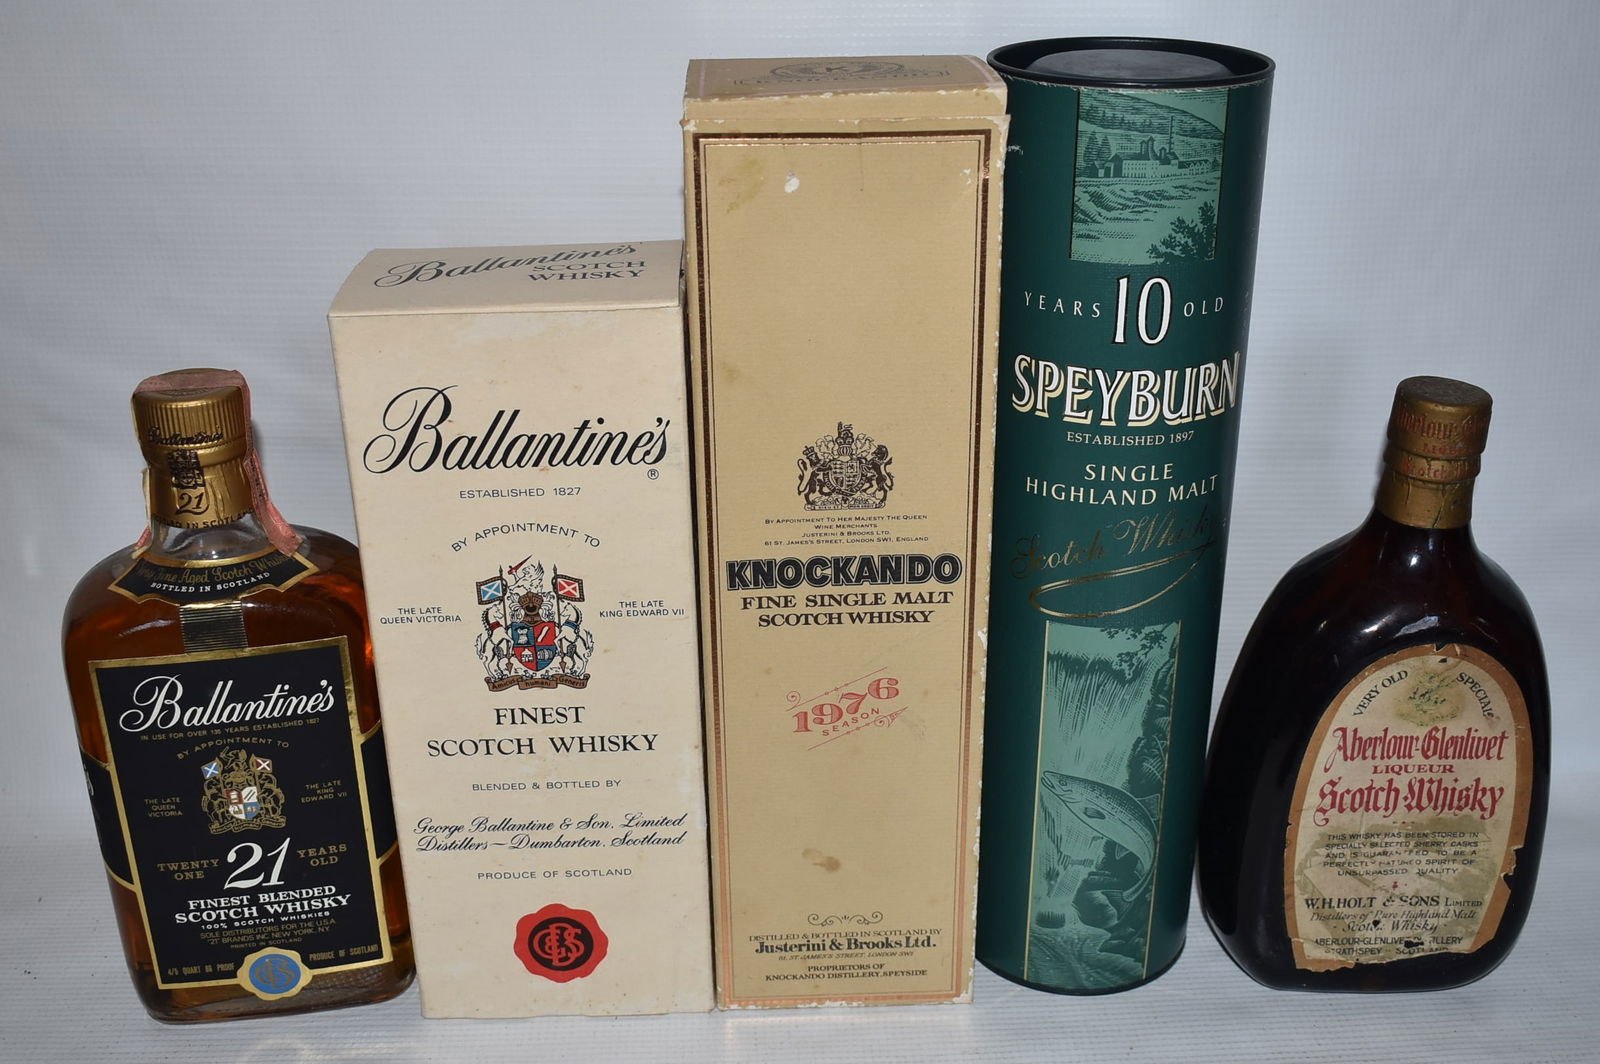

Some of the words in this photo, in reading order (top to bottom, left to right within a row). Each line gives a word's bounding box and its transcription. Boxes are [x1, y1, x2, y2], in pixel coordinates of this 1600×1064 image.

[374, 244, 637, 288] Ballantine's
[531, 260, 645, 272] SCOTCH
[527, 269, 645, 282] WHISKY
[1024, 291, 1101, 318] YEARS
[1112, 274, 1173, 345] 10
[1183, 297, 1224, 317] OLD
[1012, 351, 1241, 427] SPEYBURN
[363, 384, 671, 474] Ballantine's
[1066, 431, 1165, 446] ESTABLISHED
[1170, 430, 1195, 443] 1897
[1084, 463, 1174, 482] SINGLE
[459, 487, 545, 500] ESTABLISHED
[553, 486, 581, 496] 1827
[1026, 476, 1157, 505] HIGHLAND
[1168, 474, 1219, 503] MALT
[175, 491, 210, 515] 21
[451, 537, 468, 552] BY
[474, 522, 579, 542] APPOINTMENT
[583, 533, 601, 548] TO
[726, 553, 963, 591] KNOCKANDO
[151, 582, 195, 592] BOTTLED
[216, 572, 270, 590] SCOTLAND
[618, 600, 638, 609] THE
[639, 599, 665, 608] LATE
[741, 594, 797, 610] FINE
[805, 593, 887, 608] SINGLE
[891, 591, 954, 605] MALT
[380, 615, 414, 625] QUEEN
[415, 614, 462, 624] VICTORIA
[397, 607, 416, 616] THE
[419, 606, 443, 615] LATE
[599, 610, 624, 618] KING
[626, 608, 670, 618] EDWARD
[671, 608, 685, 616] VII
[758, 612, 842, 627] SCOTCH
[846, 610, 936, 625] WHISKY
[1352, 686, 1381, 717] VERY
[1381, 670, 1409, 689] OLD
[119, 674, 335, 732] Ballantine's
[792, 677, 899, 733] 1976
[494, 706, 586, 726] FINEST
[822, 708, 880, 736] SEASON
[169, 732, 184, 740] FOR
[187, 730, 207, 738] OVER
[224, 726, 249, 734] YEARS
[252, 720, 303, 731] ESTABLISHED
[177, 750, 189, 760] BY
[194, 736, 273, 752] APPOINTMENT
[427, 737, 536, 758] SCOTCH
[548, 733, 658, 754] WHISKY
[1372, 764, 1456, 776] LIQUEUR
[305, 783, 319, 791] THE
[322, 780, 342, 788] LATE
[316, 786, 335, 794] KING
[472, 781, 527, 792] BLENDED
[531, 781, 541, 790] &
[546, 780, 601, 790] BOTTLED
[605, 779, 622, 788] BY
[300, 793, 335, 803] EDWARD
[1313, 776, 1402, 827] Scotch
[1403, 777, 1505, 820] Whisky
[148, 810, 183, 818] VICTORIA
[151, 804, 176, 812] QUEEN
[413, 816, 465, 839] George
[468, 816, 555, 834] Ballantine
[559, 817, 574, 830] &
[619, 812, 689, 830] Limited
[415, 834, 489, 853] Distillers
[610, 830, 689, 848] Scotland
[1350, 832, 1381, 840] WHISKY
[1431, 831, 1465, 839] STORED
[1413, 840, 1448, 848] SHERRY
[1450, 840, 1479, 848] CASKS
[296, 844, 348, 858] YEARS
[157, 858, 221, 872] TWENTY
[223, 837, 291, 890] 21
[310, 855, 339, 867] OLD
[174, 870, 205, 881] ONE
[477, 871, 537, 881] PRODUCE
[543, 870, 559, 878] OF
[565, 868, 633, 878] SCOTLAND
[187, 894, 251, 910] FINEST
[257, 885, 337, 903] BLENDED
[1399, 895, 1440, 907] SONS
[174, 906, 259, 924] SCOTCH
[263, 894, 352, 914] WHISKY
[201, 922, 228, 930] 100%
[233, 917, 275, 927] SCOTCH
[280, 911, 331, 922] WHISKIES
[749, 932, 800, 942] DISTILLED
[801, 932, 810, 940] &
[811, 930, 860, 939] BOTTLED
[873, 929, 929, 937] SCOTLAND
[755, 939, 826, 954] Justerini
[828, 939, 844, 951] &
[847, 937, 902, 950] Brooks
[904, 935, 937, 948] Ltd.
[765, 973, 826, 981] KNOCKANDO
[883, 969, 928, 977] SPEYSIDE
[807, 963, 871, 972] PROPRIETORS
